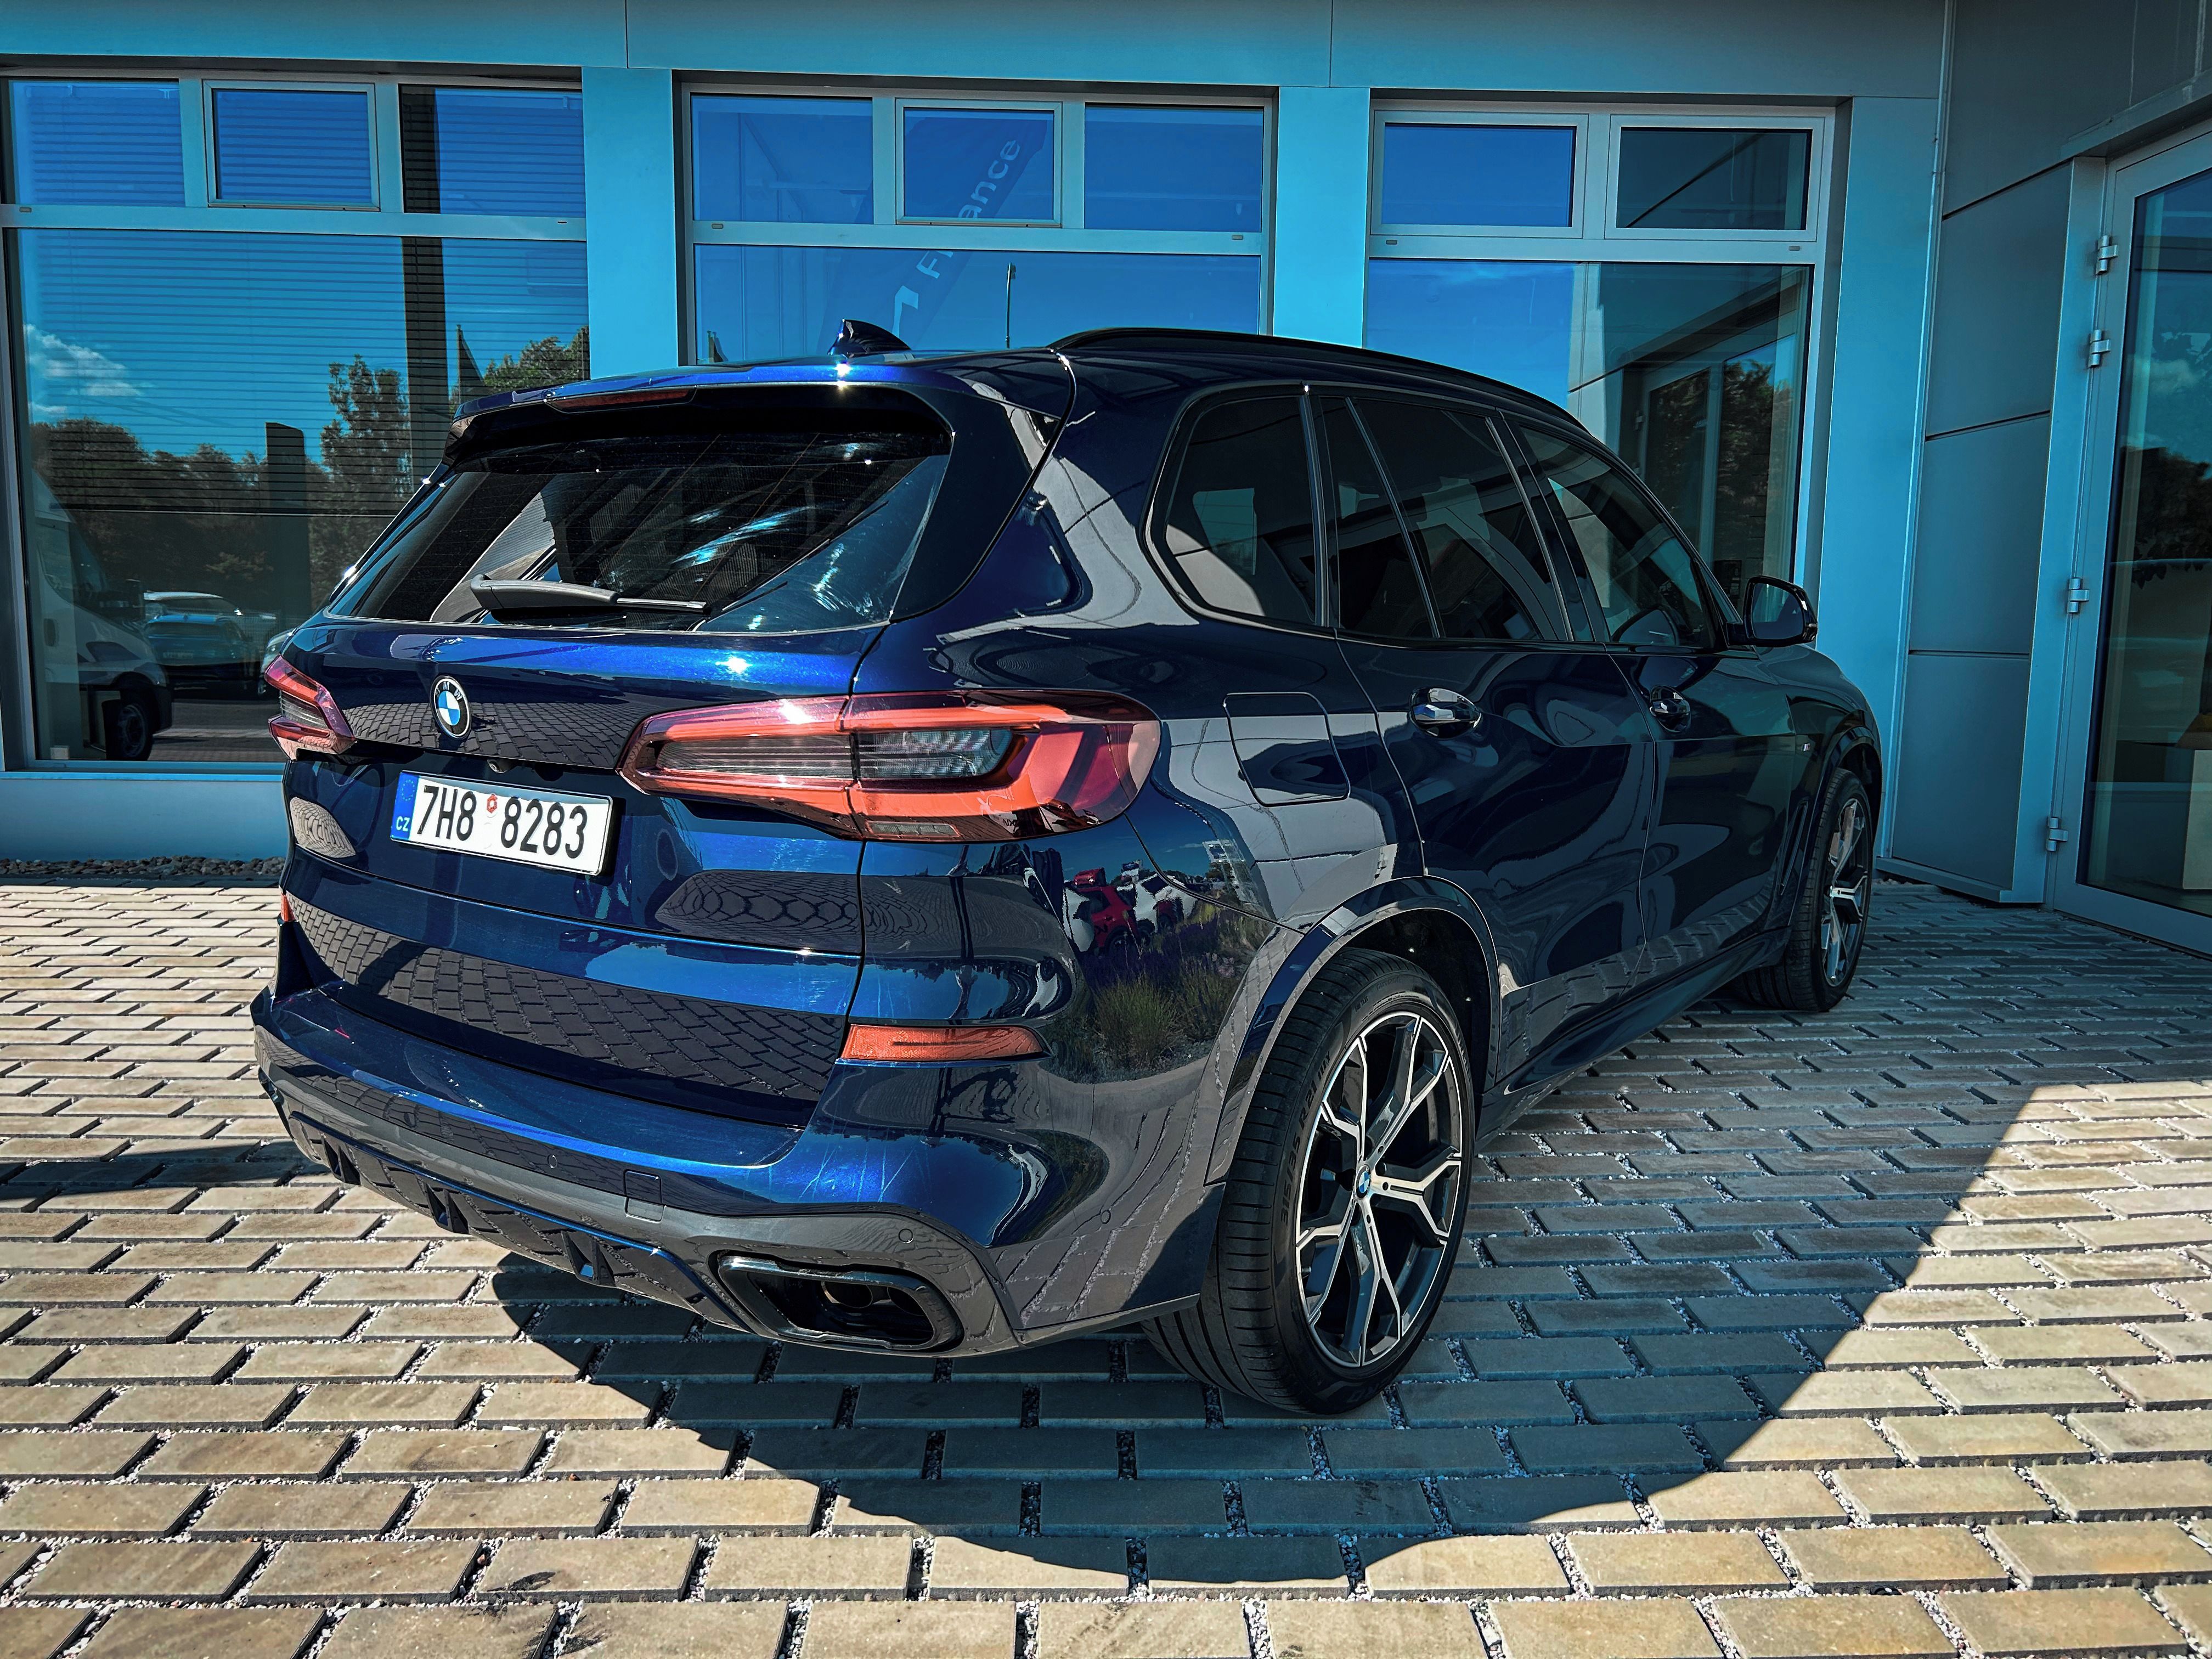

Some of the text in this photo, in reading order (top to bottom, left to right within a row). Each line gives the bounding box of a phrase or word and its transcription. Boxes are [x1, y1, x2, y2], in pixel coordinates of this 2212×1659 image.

[436, 681, 463, 701] BMW
[396, 816, 410, 832] CZ
[417, 785, 588, 859] 7H8 8283
